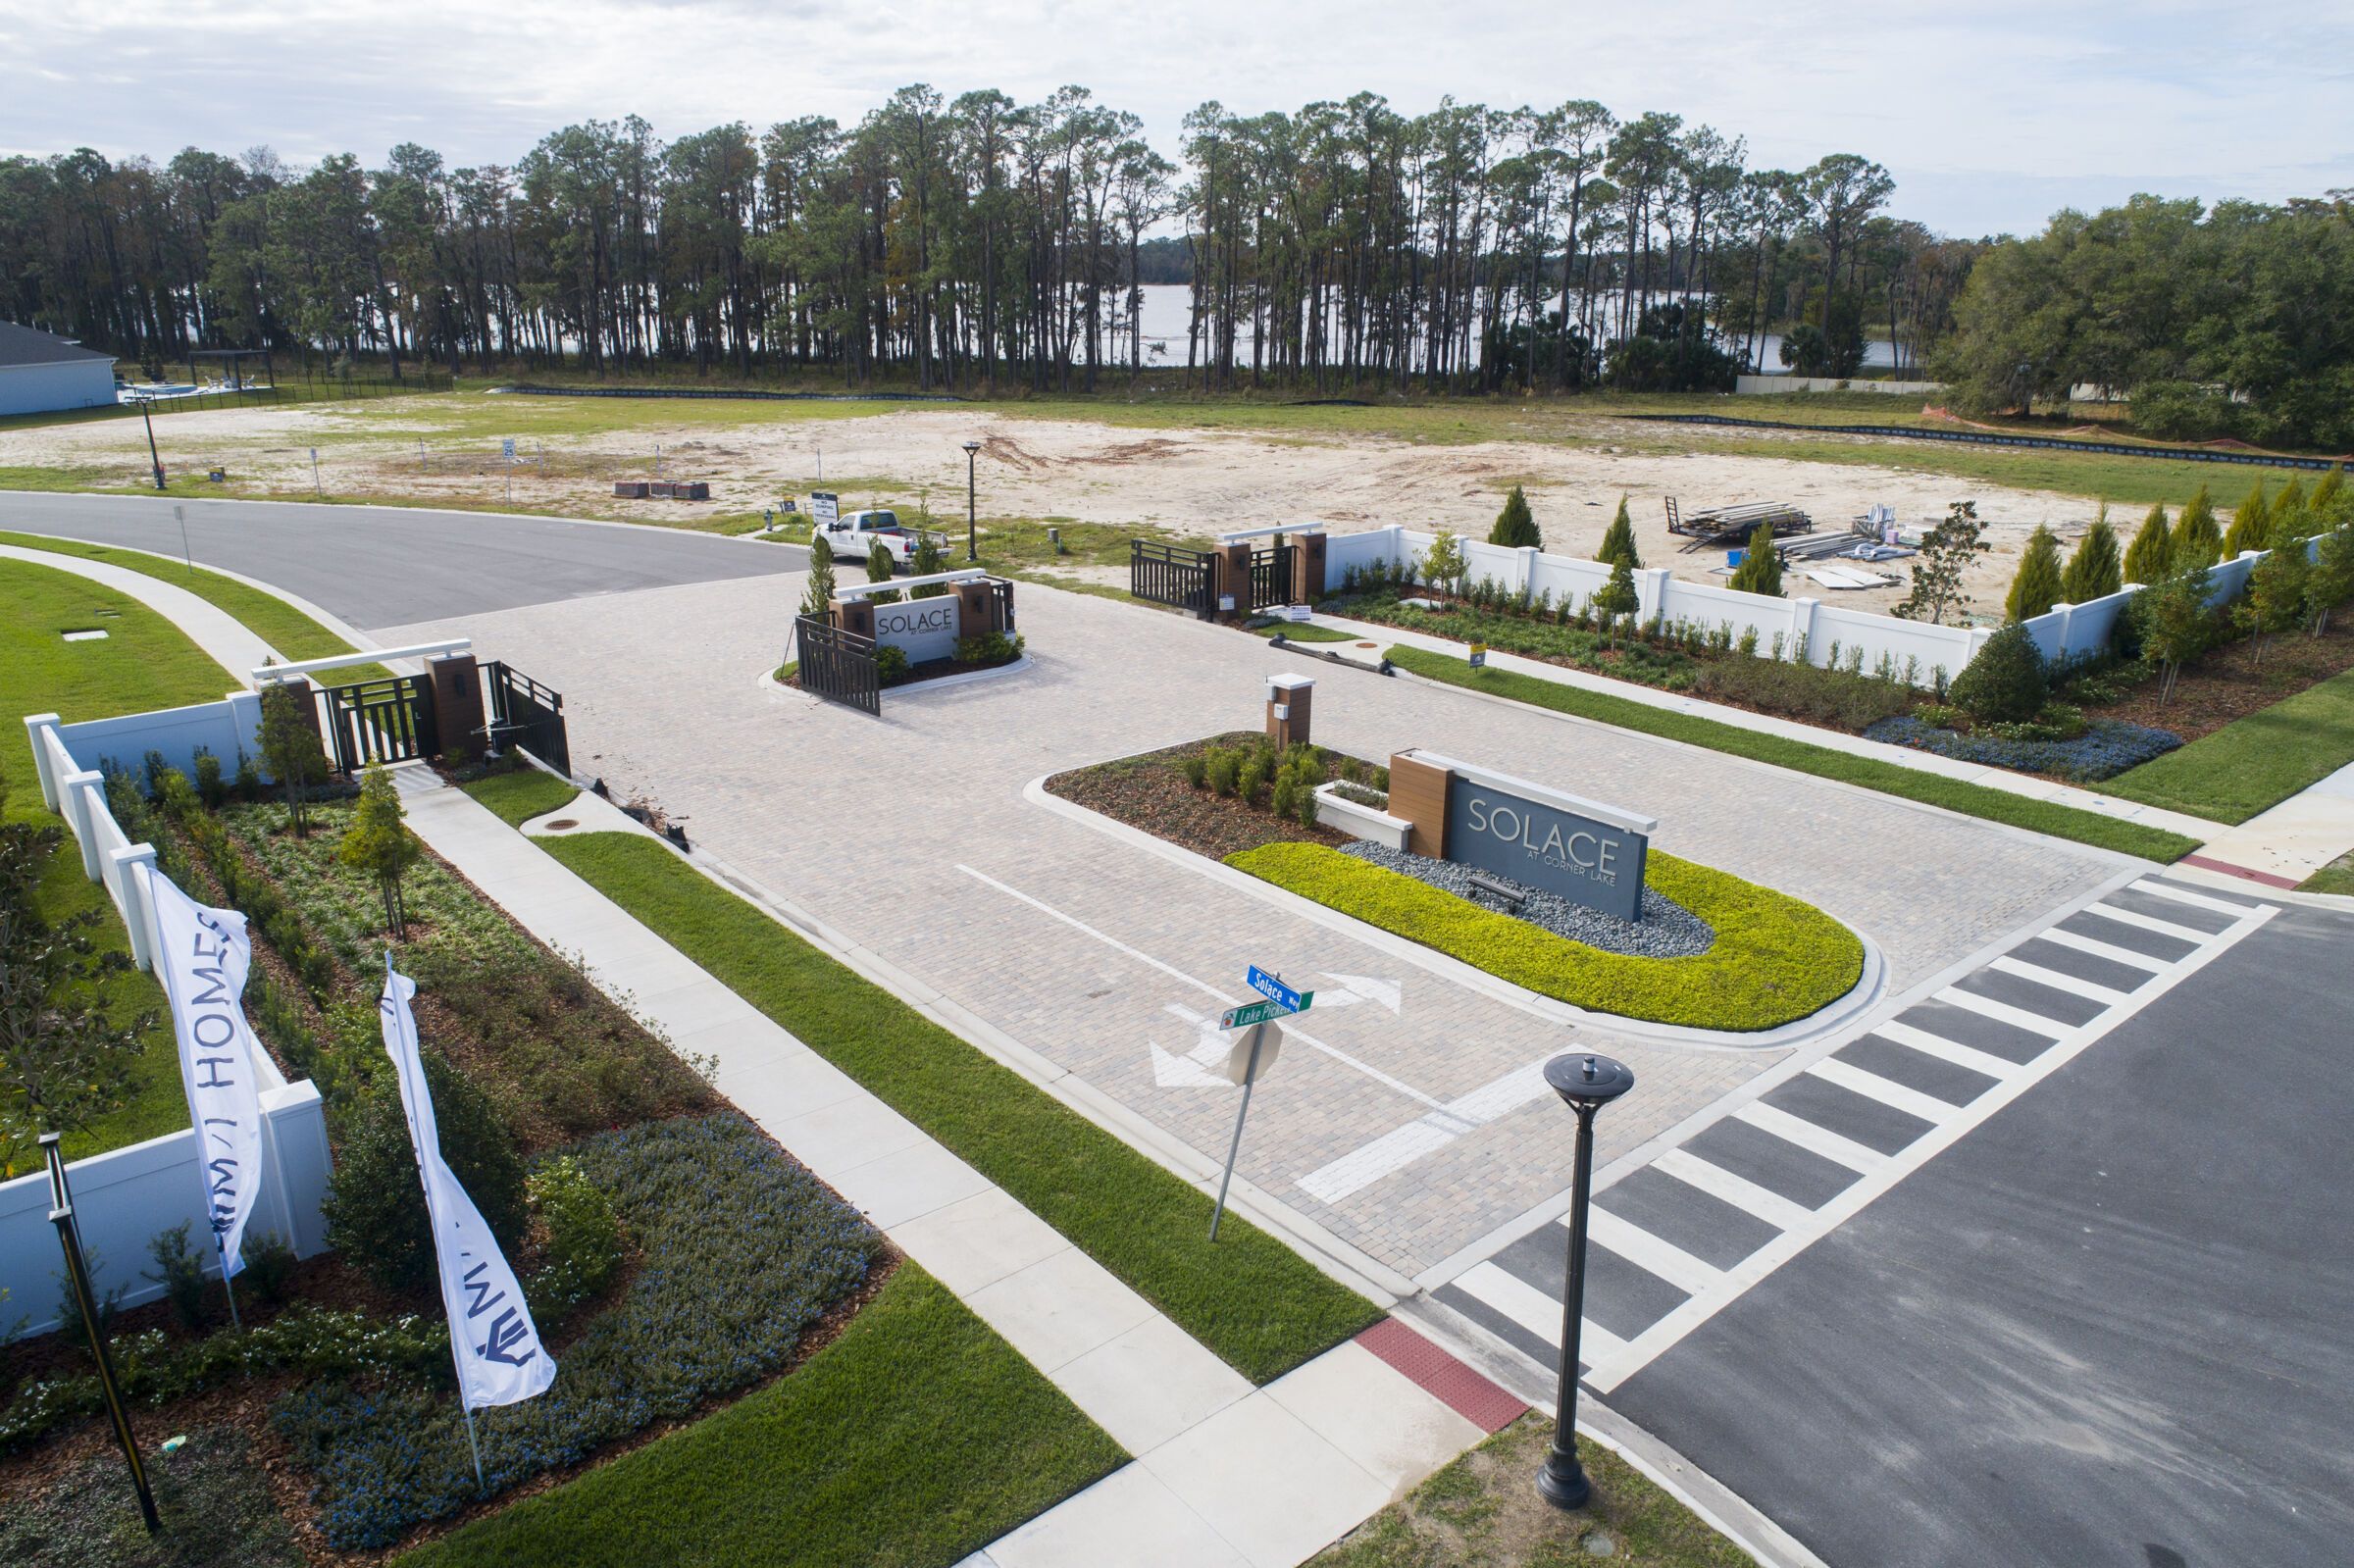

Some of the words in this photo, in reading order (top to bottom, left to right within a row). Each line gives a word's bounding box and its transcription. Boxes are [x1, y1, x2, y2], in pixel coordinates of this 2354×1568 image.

[878, 608, 952, 635] SOLACE
[1467, 798, 1619, 877] SOLACE
[1527, 850, 1540, 861] AT
[1544, 855, 1586, 877] CORNER
[1590, 871, 1616, 887] LAKE
[1254, 972, 1283, 1002] Solace
[1288, 995, 1299, 1010] Way
[1239, 1007, 1260, 1025] Lake
[1261, 1004, 1291, 1020] Picke
